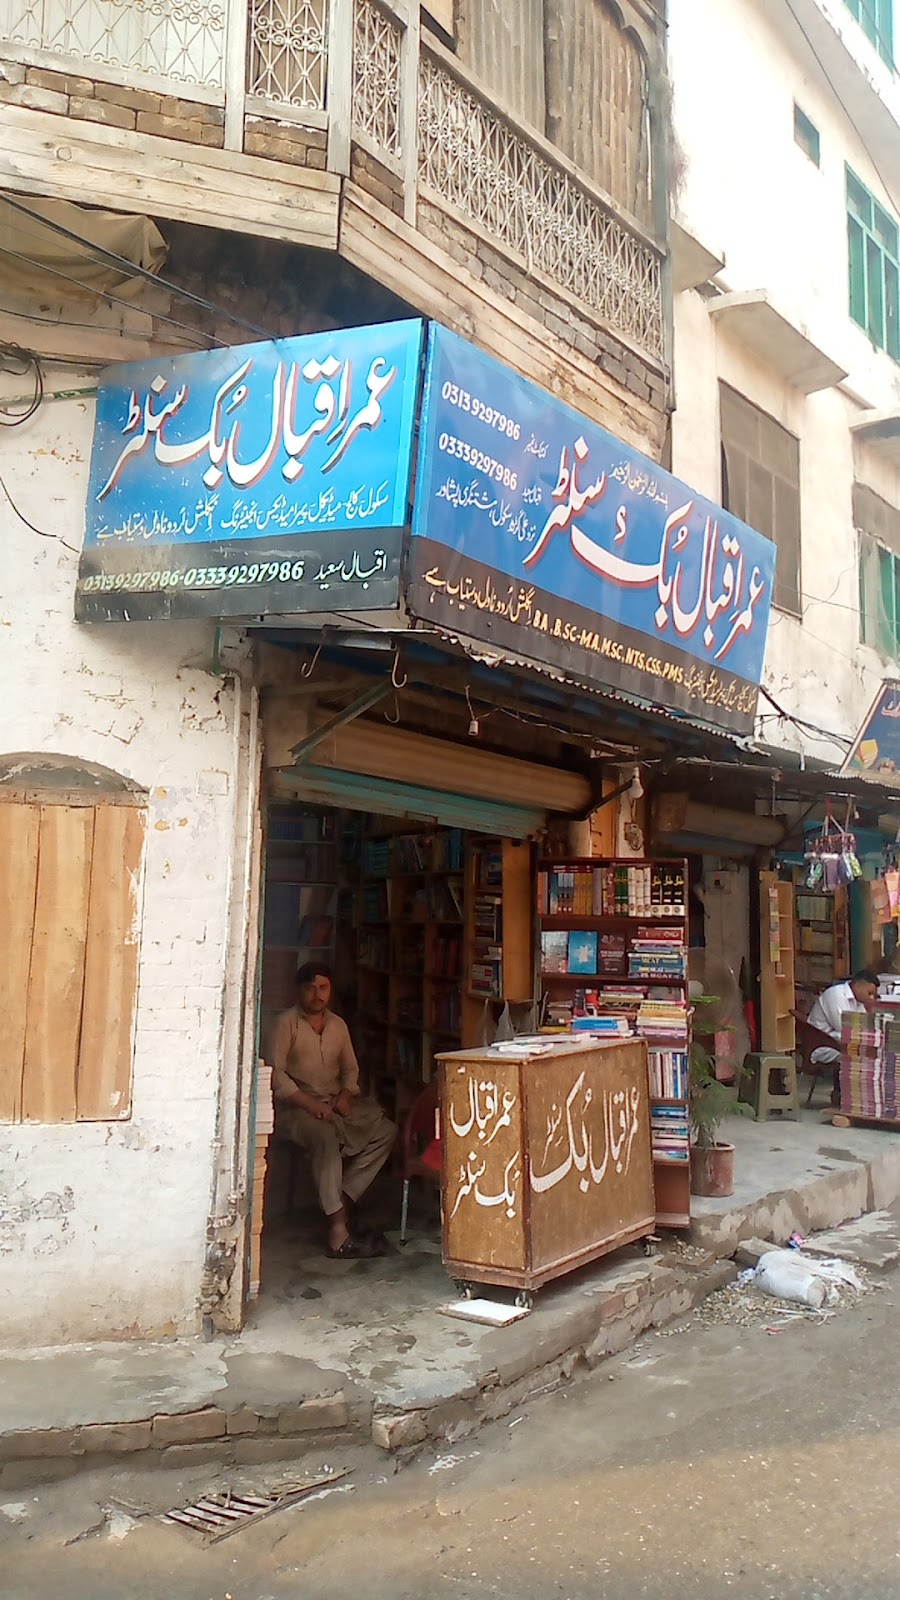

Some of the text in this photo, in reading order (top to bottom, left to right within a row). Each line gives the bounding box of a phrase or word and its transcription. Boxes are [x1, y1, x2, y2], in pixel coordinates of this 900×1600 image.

[320, 357, 397, 474] عمر
[441, 381, 521, 440] 03139297986
[439, 432, 518, 491] 03339297986
[313, 560, 344, 589] سعید
[341, 551, 387, 589] اقبال
[714, 566, 765, 660] عمر
[450, 1076, 516, 1146] عمر اقبال
[624, 1086, 640, 1176] عمر
